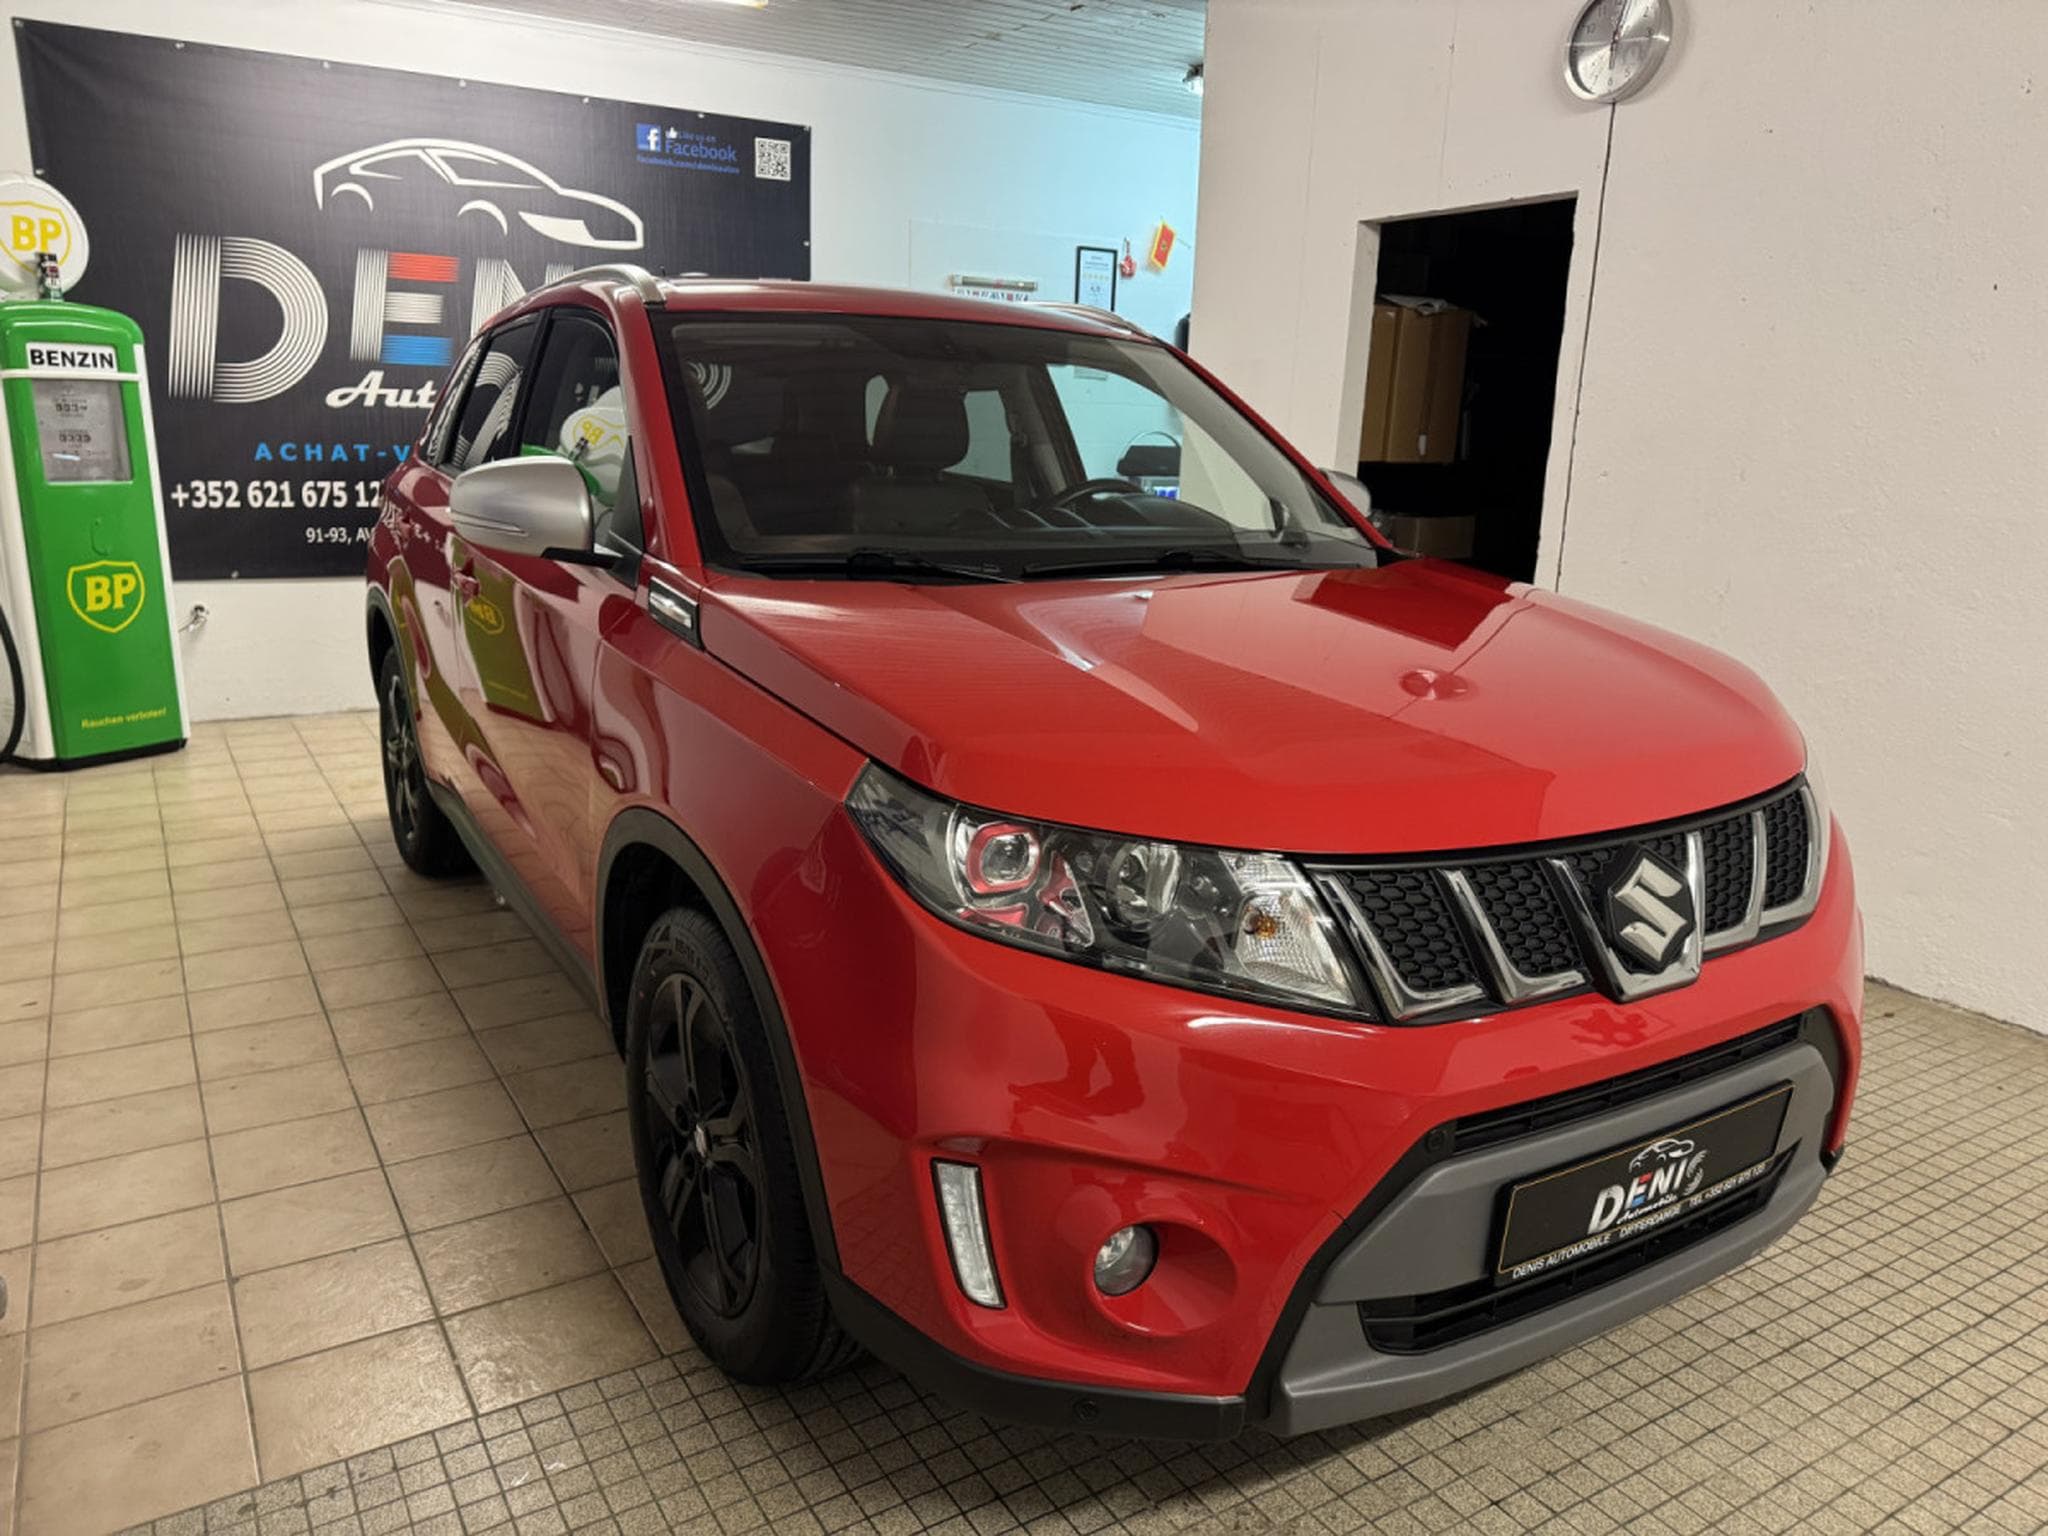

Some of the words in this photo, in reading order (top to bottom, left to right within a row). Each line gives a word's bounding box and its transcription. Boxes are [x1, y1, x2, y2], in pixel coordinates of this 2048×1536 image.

[665, 138, 738, 162] Facebook
[11, 214, 62, 254] BP
[29, 348, 115, 369] BENZIN
[254, 442, 412, 462] ACHAT-V
[170, 480, 242, 509] +352
[247, 480, 295, 509] 621
[301, 480, 348, 509] 675
[355, 480, 384, 508] 12
[305, 527, 352, 545] 91-93,
[85, 573, 137, 612] BP
[1587, 1150, 1707, 1235] DENIS
[1512, 1257, 1545, 1279] DENIS
